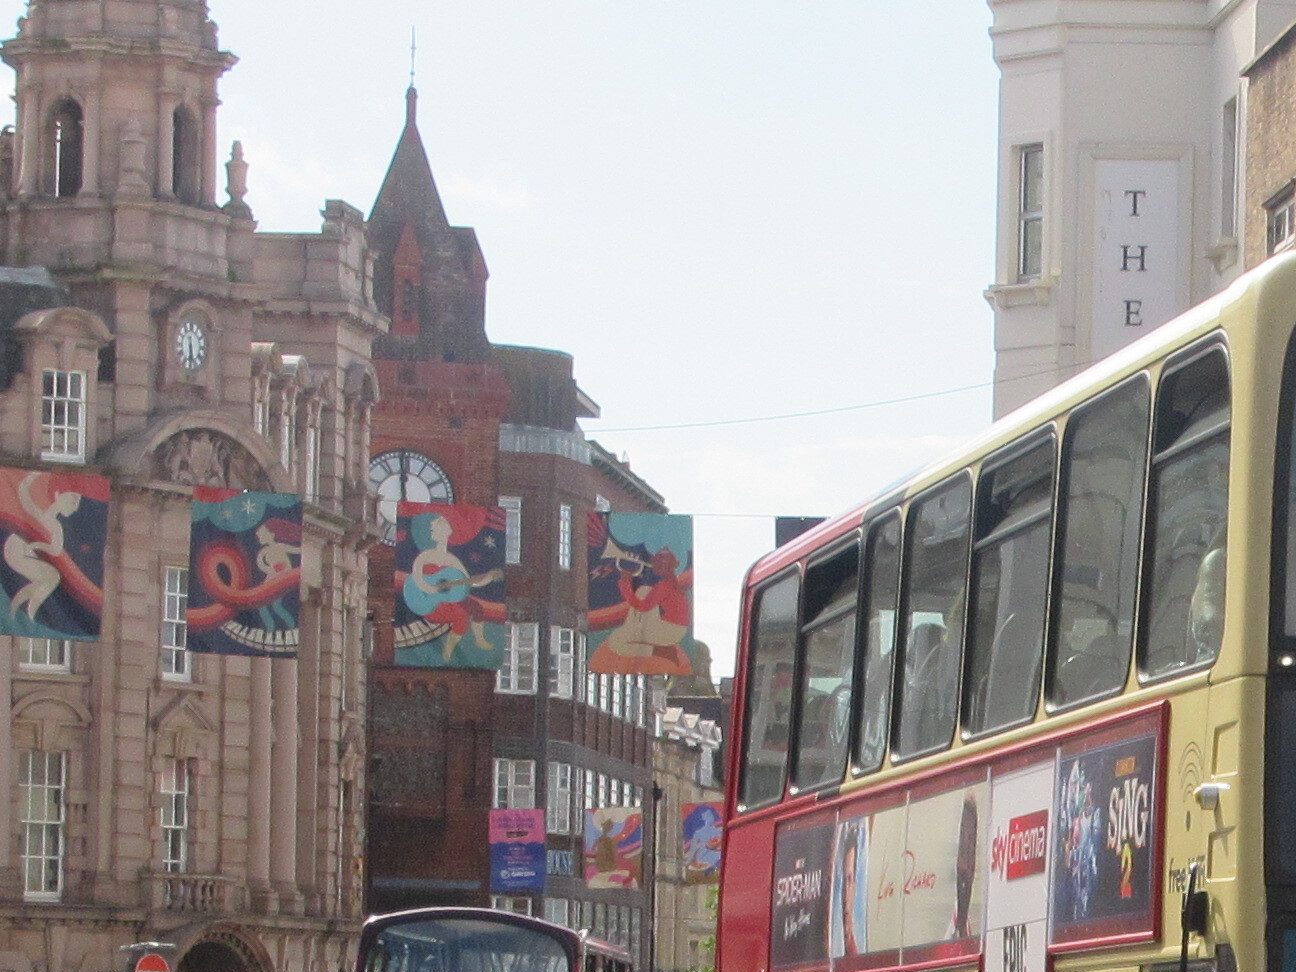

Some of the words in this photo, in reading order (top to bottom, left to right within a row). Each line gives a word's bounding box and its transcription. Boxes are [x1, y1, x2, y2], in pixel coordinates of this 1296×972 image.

[1120, 190, 1148, 327] THE
[991, 826, 1008, 882] sky
[1009, 823, 1046, 864] cinema
[1120, 843, 1133, 899] 2
